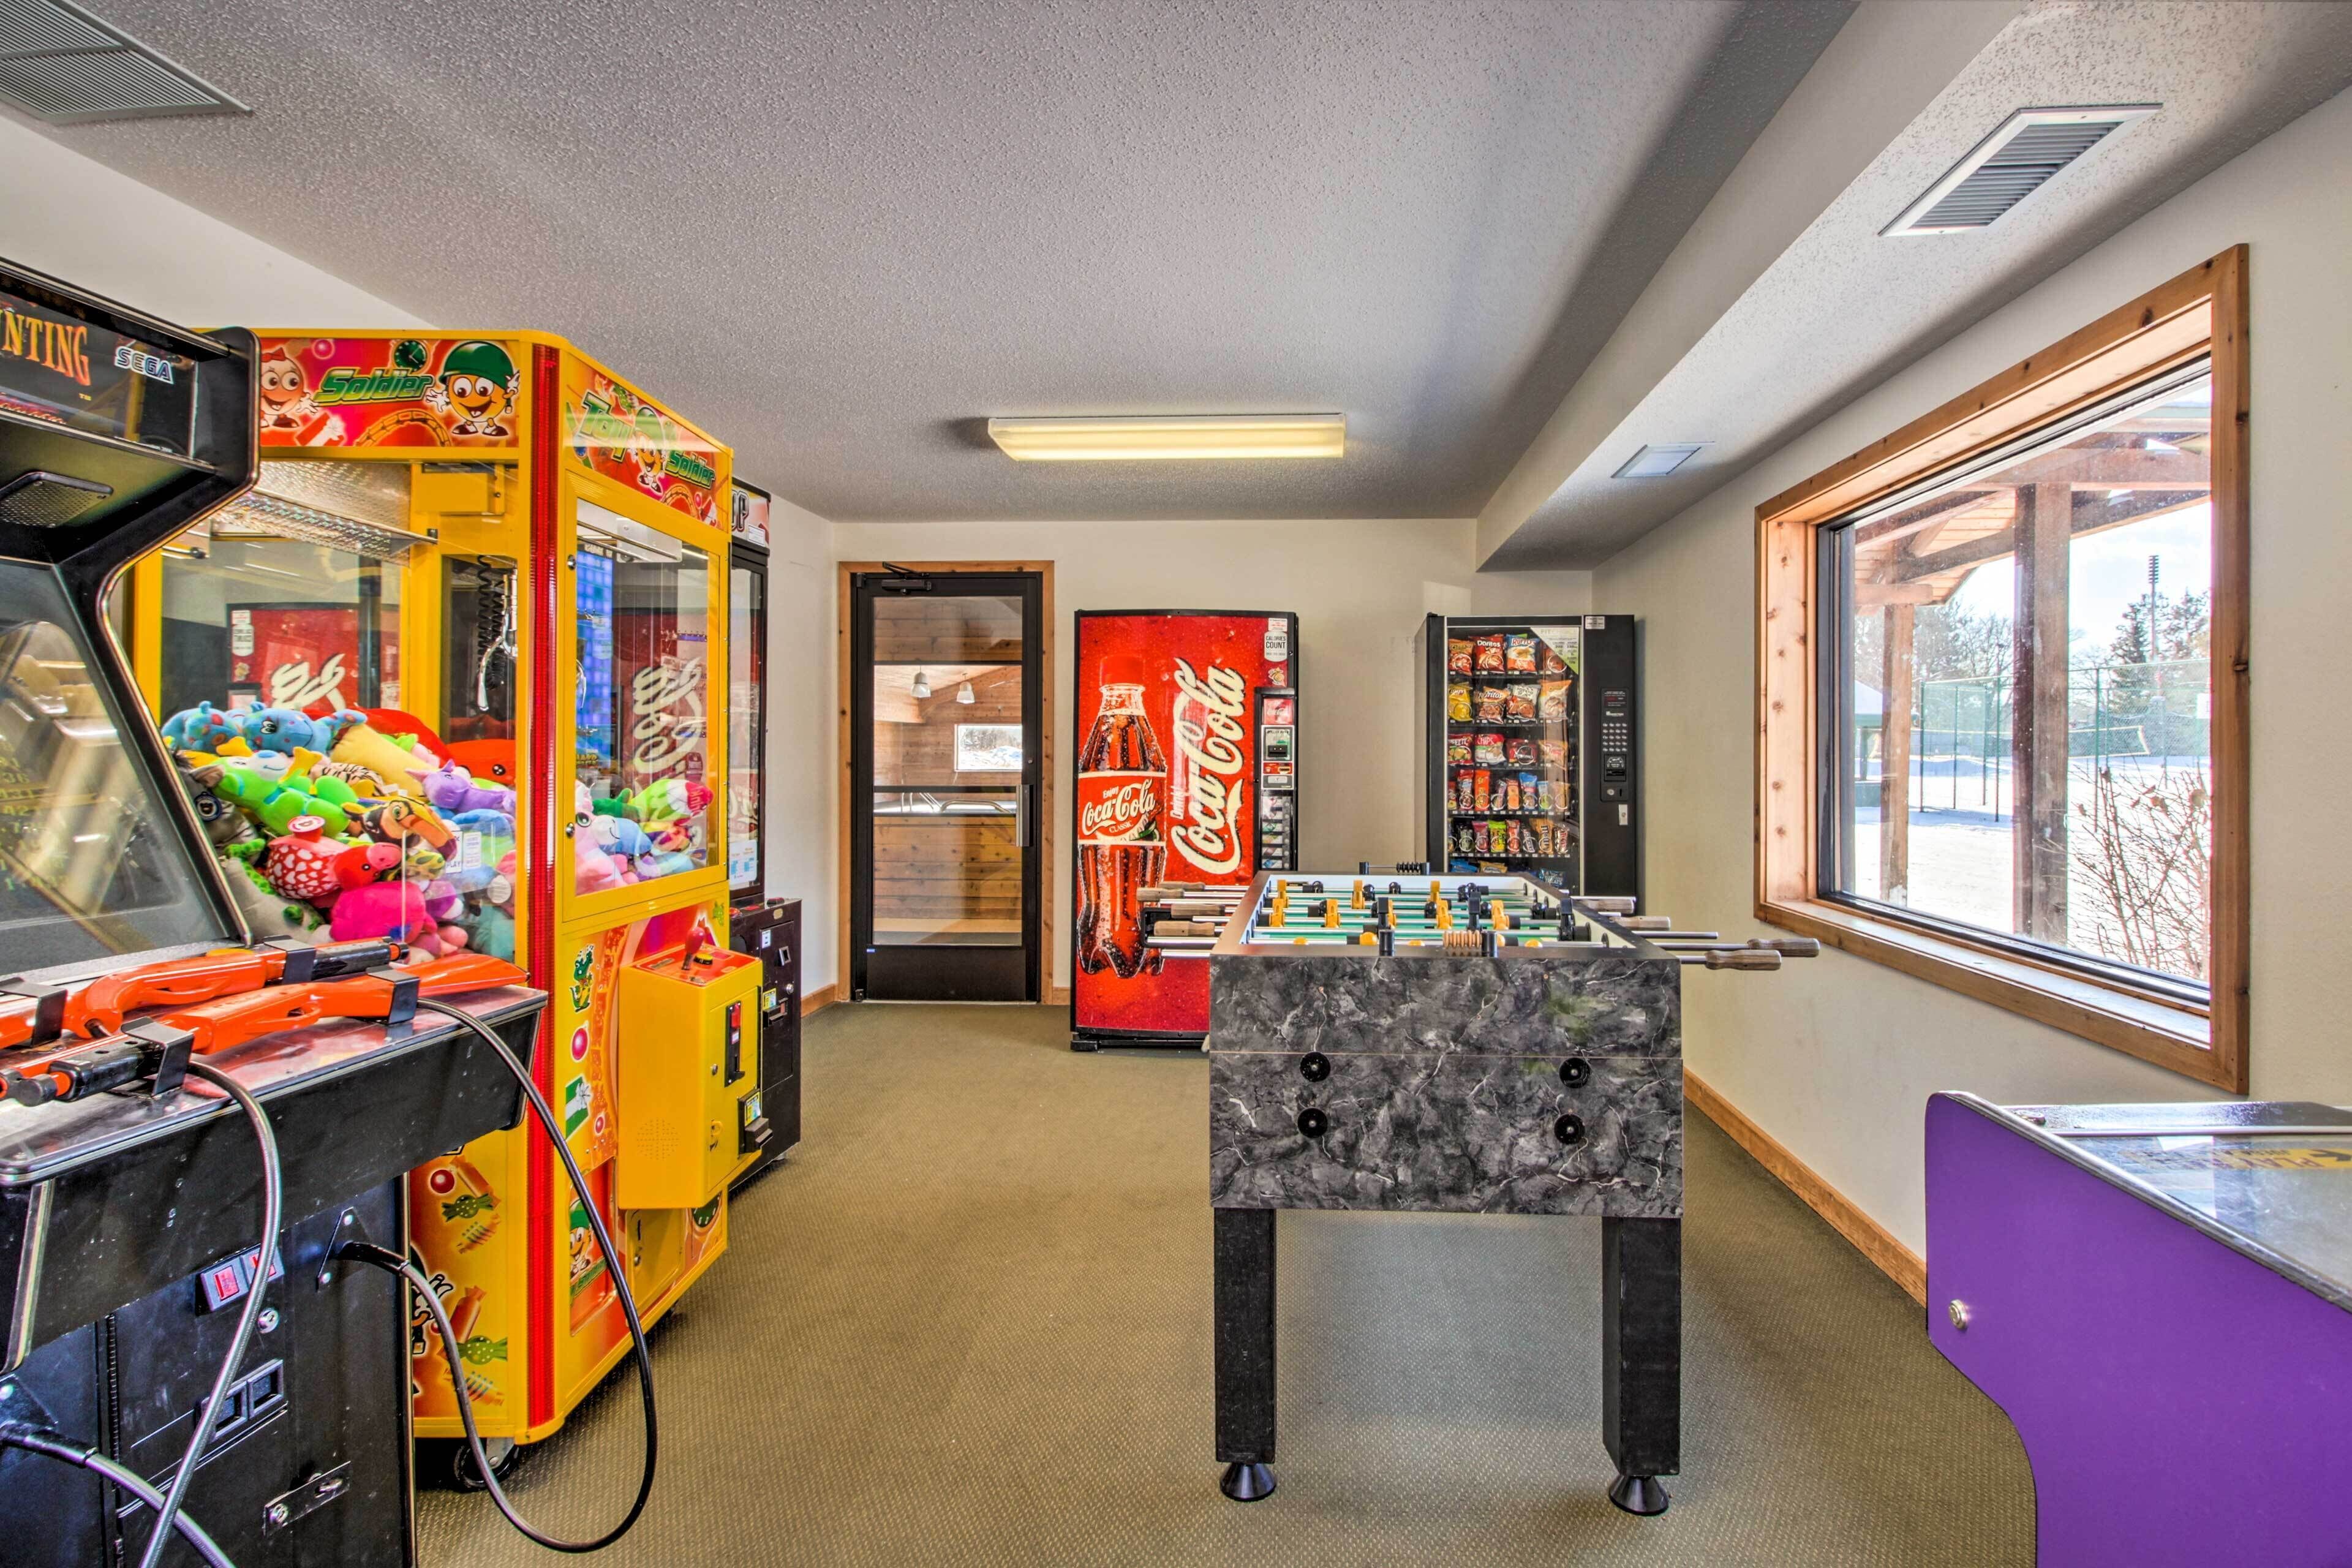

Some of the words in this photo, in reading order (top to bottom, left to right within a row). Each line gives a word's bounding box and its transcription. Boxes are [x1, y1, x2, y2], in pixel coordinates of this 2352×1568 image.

[115, 345, 174, 385] SEGA
[315, 368, 435, 406] Soldier
[579, 389, 634, 464] Toy
[666, 449, 715, 490] Soldier
[1082, 778, 1156, 835] Coca-Cola
[1102, 786, 1119, 798] Enjoy
[1109, 821, 1133, 834] CLASSIC
